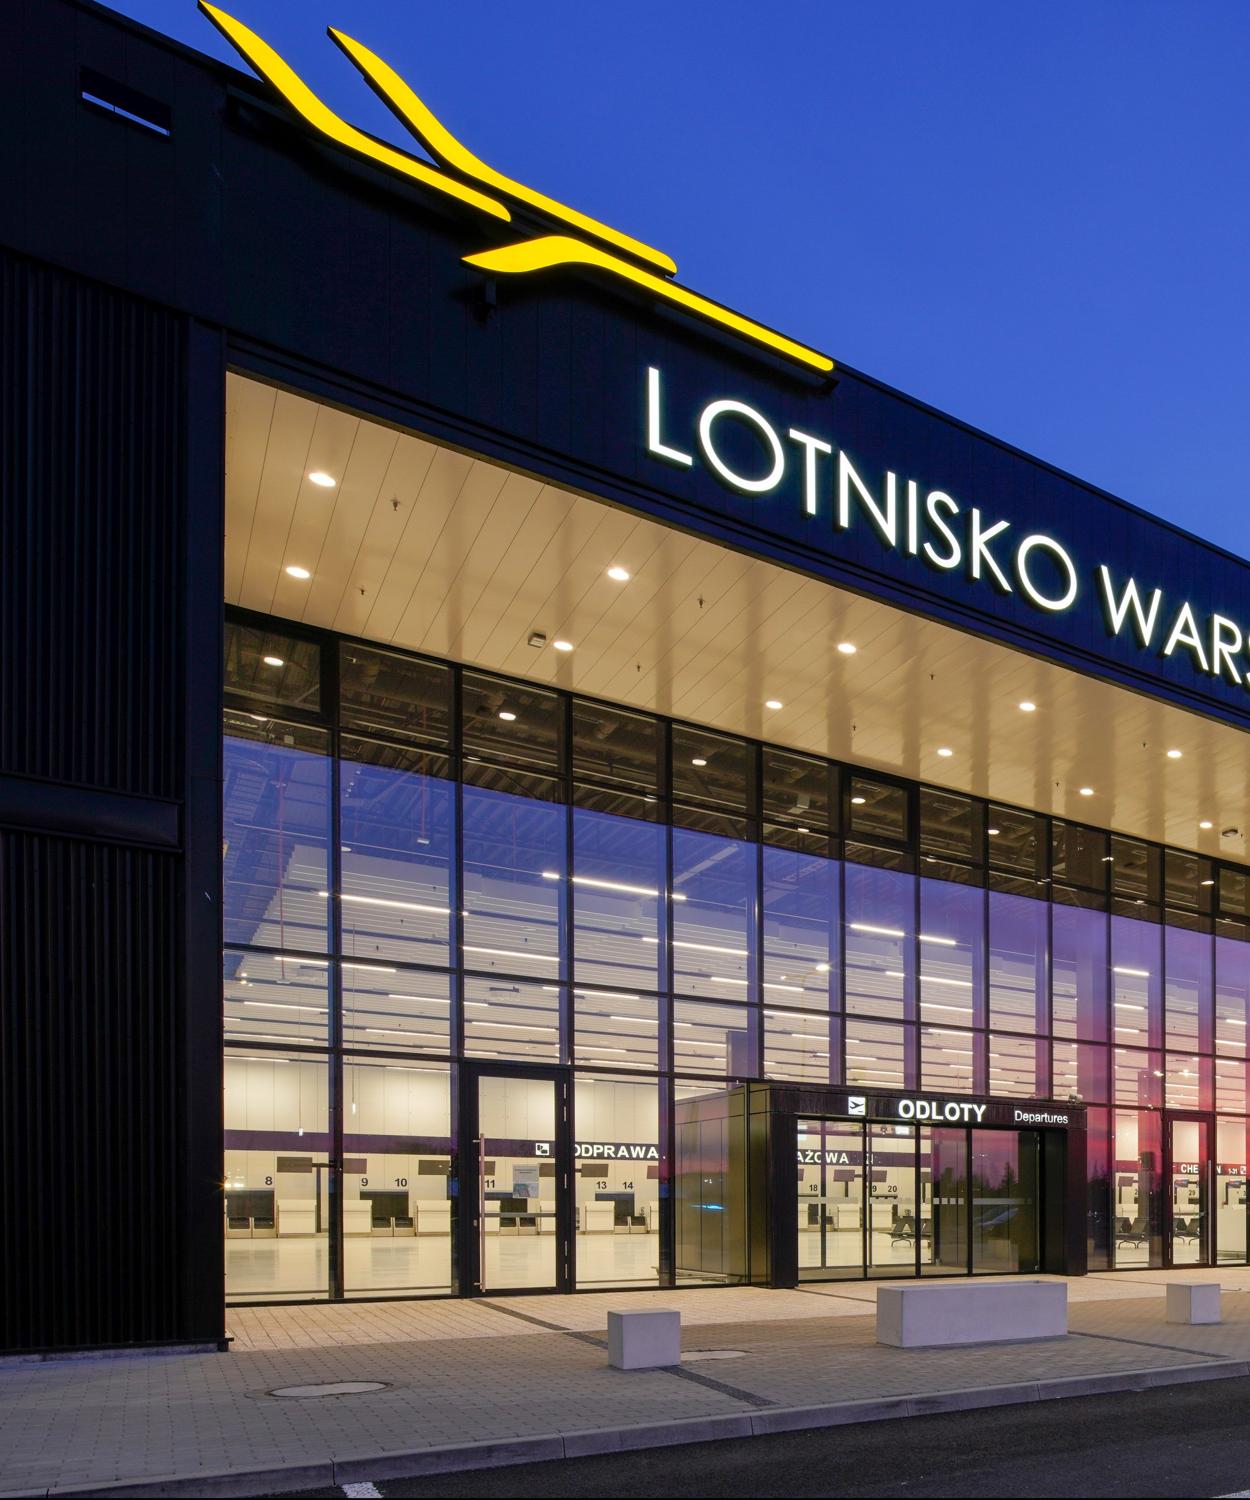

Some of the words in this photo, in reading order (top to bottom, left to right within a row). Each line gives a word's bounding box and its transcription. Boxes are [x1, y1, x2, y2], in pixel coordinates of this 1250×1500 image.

[648, 366, 1078, 611] LOTNISKO
[898, 1100, 986, 1122] ODLOTY
[1014, 1110, 1068, 1124] Departures
[265, 1176, 273, 1185] 8
[361, 1177, 369, 1187] 9
[395, 1178, 408, 1187] 10
[485, 1179, 496, 1189] 11
[596, 1181, 607, 1190] 13
[622, 1181, 633, 1190] 14
[809, 1184, 818, 1192] 18
[888, 1185, 898, 1193] 20
